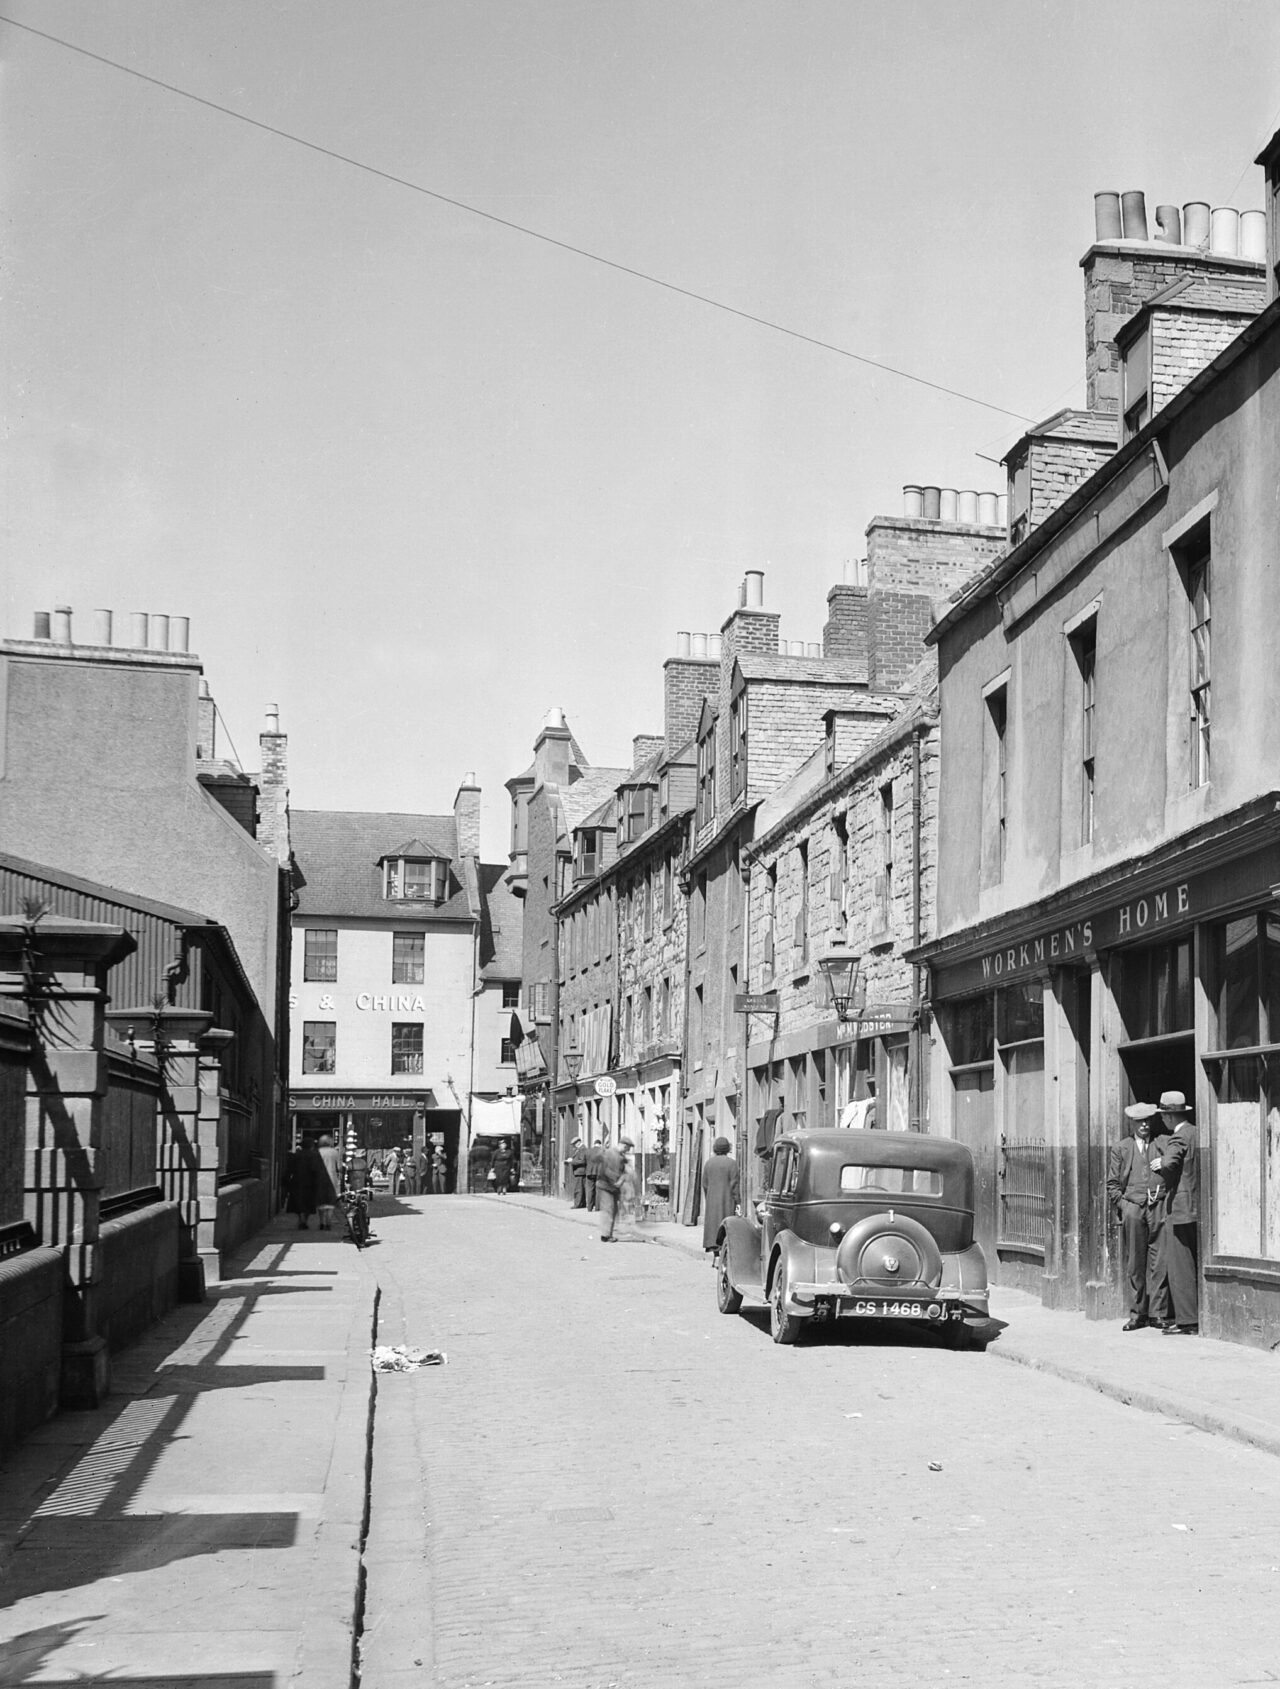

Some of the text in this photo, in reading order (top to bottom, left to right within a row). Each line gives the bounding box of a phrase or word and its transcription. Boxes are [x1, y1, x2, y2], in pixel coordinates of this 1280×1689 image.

[981, 883, 1190, 979] WORKMEN'S HOME
[318, 994, 335, 1011] &
[355, 992, 426, 1012] CHINA
[311, 1095, 356, 1108] CHINA
[855, 1301, 921, 1316] CS 1468
